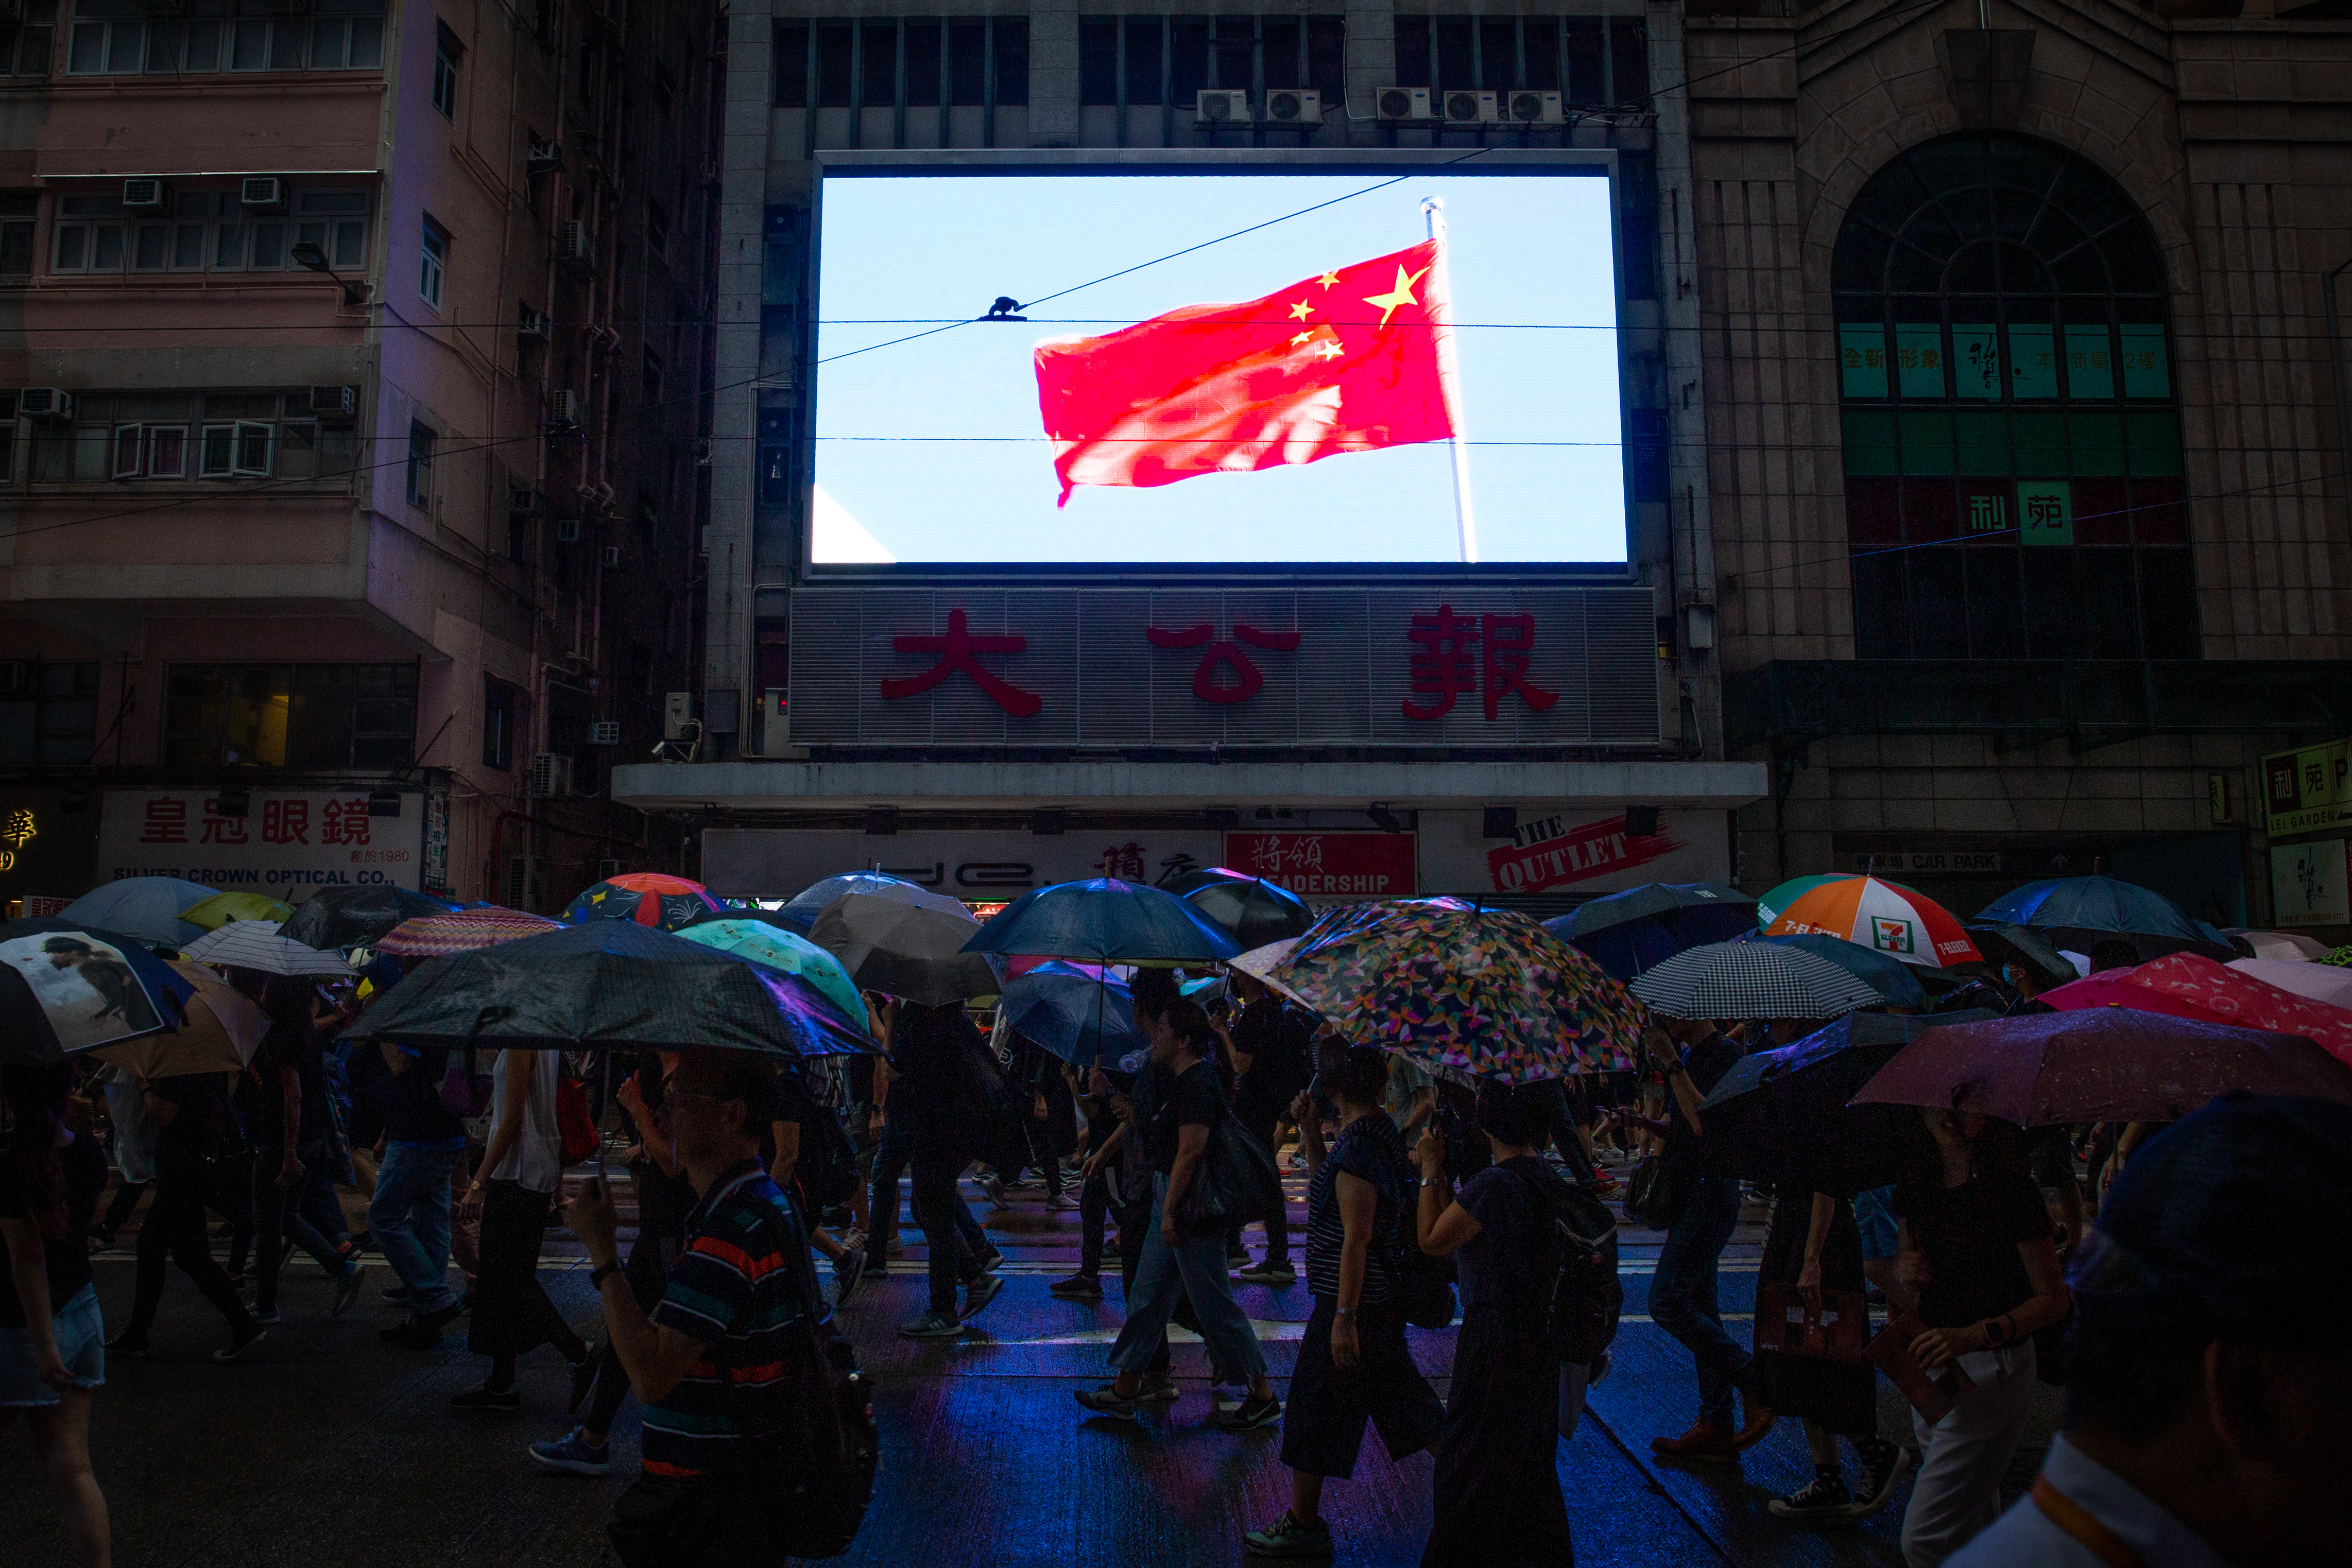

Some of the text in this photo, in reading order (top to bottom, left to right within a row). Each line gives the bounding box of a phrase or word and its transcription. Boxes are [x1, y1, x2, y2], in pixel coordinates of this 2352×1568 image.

[1844, 348, 1941, 370] 全新形象
[1970, 495, 2063, 530] 利苑
[881, 604, 1558, 721] 大公報
[2274, 763, 2323, 800] 利苑
[3, 811, 36, 848] 華
[140, 796, 370, 845] 皇冠眼鏡
[1514, 815, 1566, 847] THE
[2271, 810, 2334, 830] LEI GARDEN
[1250, 835, 1324, 874] 將領
[1499, 832, 1627, 889] OUTLET
[1912, 855, 1997, 869] CAR PARK
[187, 869, 259, 883] CROWN
[266, 870, 350, 884] OPTICAL
[1254, 874, 1389, 892] EADERSHIP
[31, 898, 75, 918] 皇冠眼
